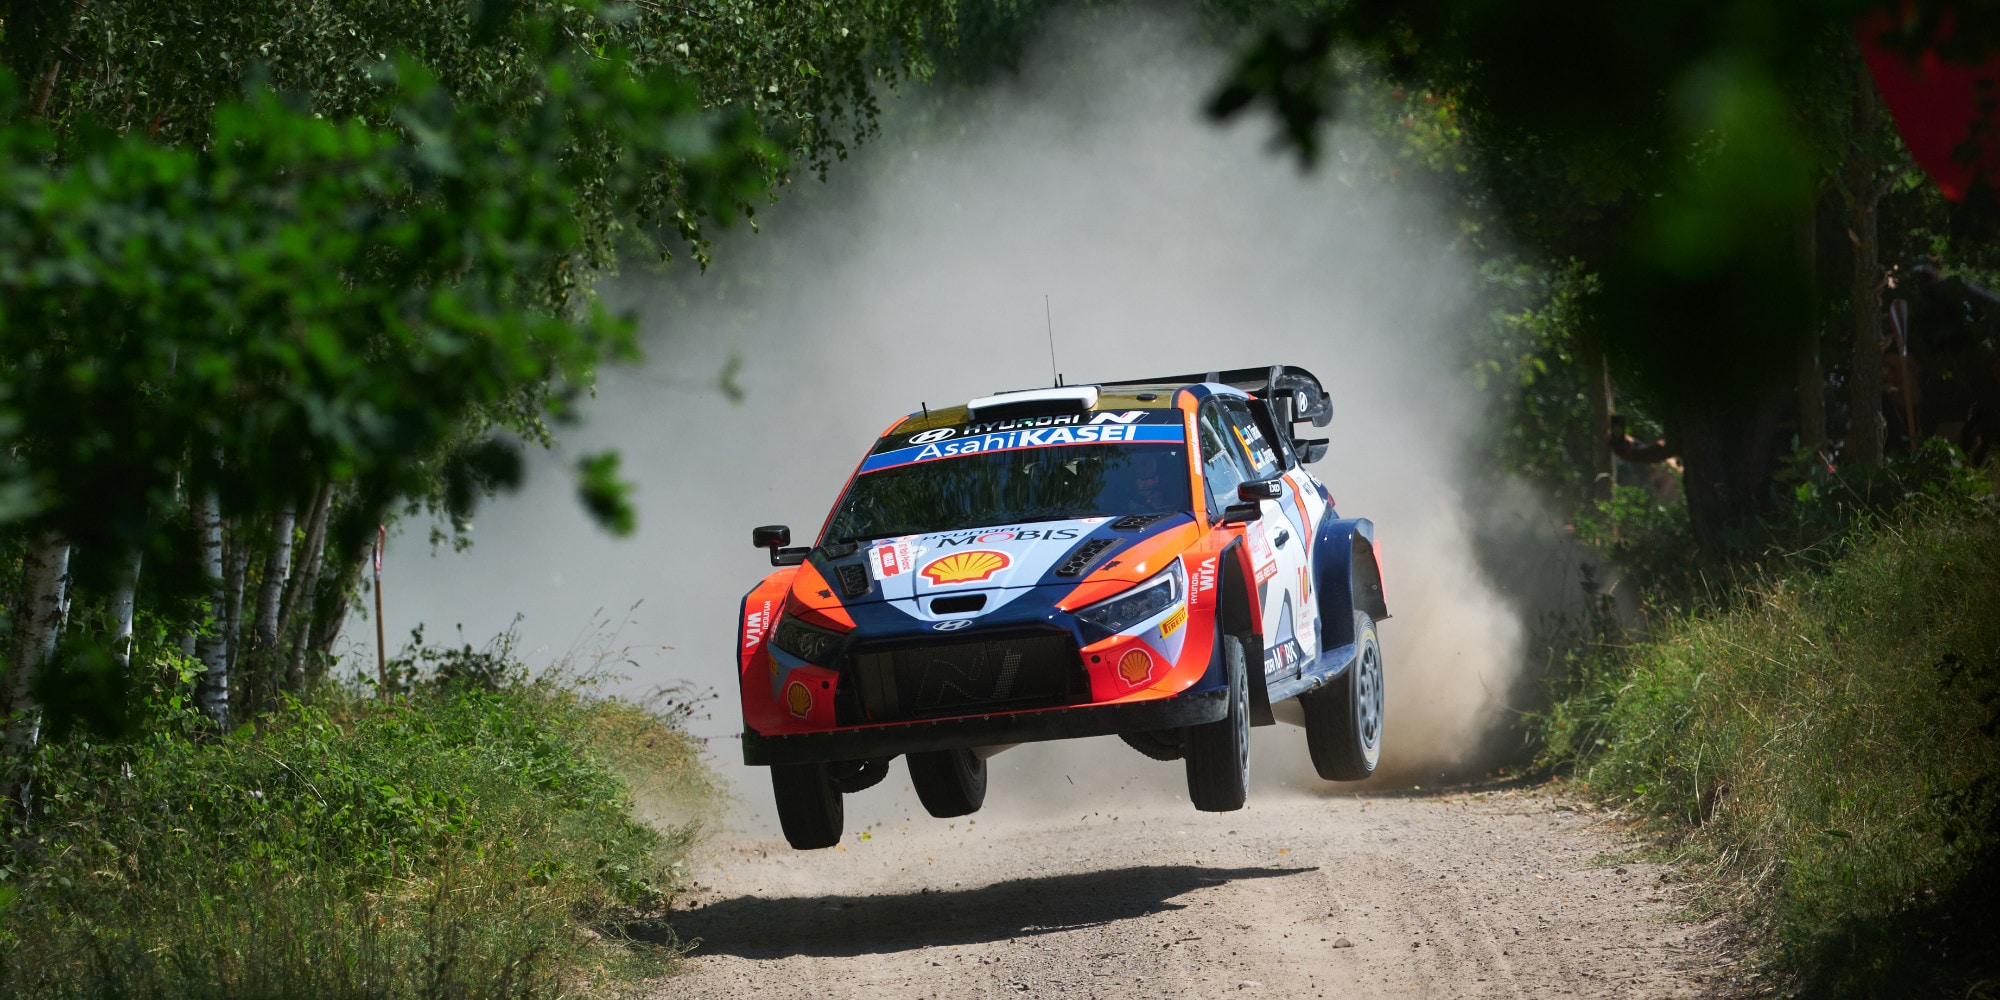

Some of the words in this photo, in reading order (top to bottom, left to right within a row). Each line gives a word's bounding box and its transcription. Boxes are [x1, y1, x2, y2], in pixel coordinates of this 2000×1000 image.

[963, 414, 1080, 435] HYUNDAI
[923, 527, 1021, 541] HYUNDAI
[936, 528, 1079, 548] MOBIS
[1191, 572, 1199, 605] HYUNDAI
[762, 600, 771, 630] HYUNDAI
